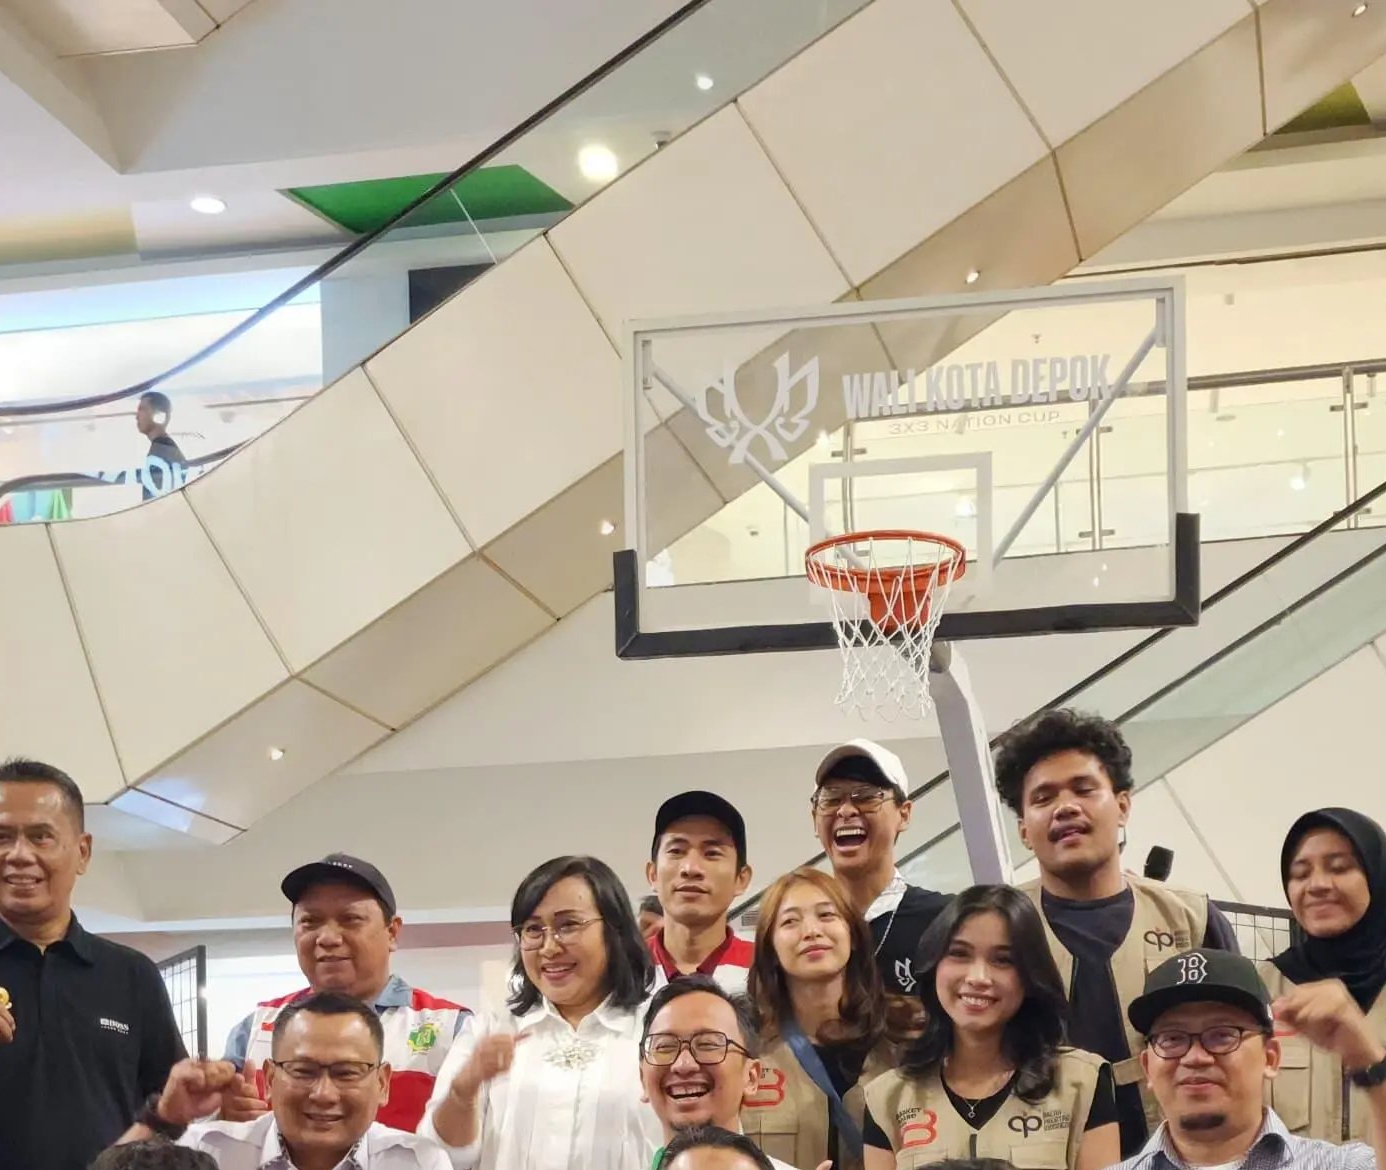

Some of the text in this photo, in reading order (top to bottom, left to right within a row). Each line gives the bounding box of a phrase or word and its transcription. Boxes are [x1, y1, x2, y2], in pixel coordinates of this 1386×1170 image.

[842, 354, 1113, 419] WALI KOTA DEPOK
[888, 410, 1060, 435] 3X3 NATION CUP
